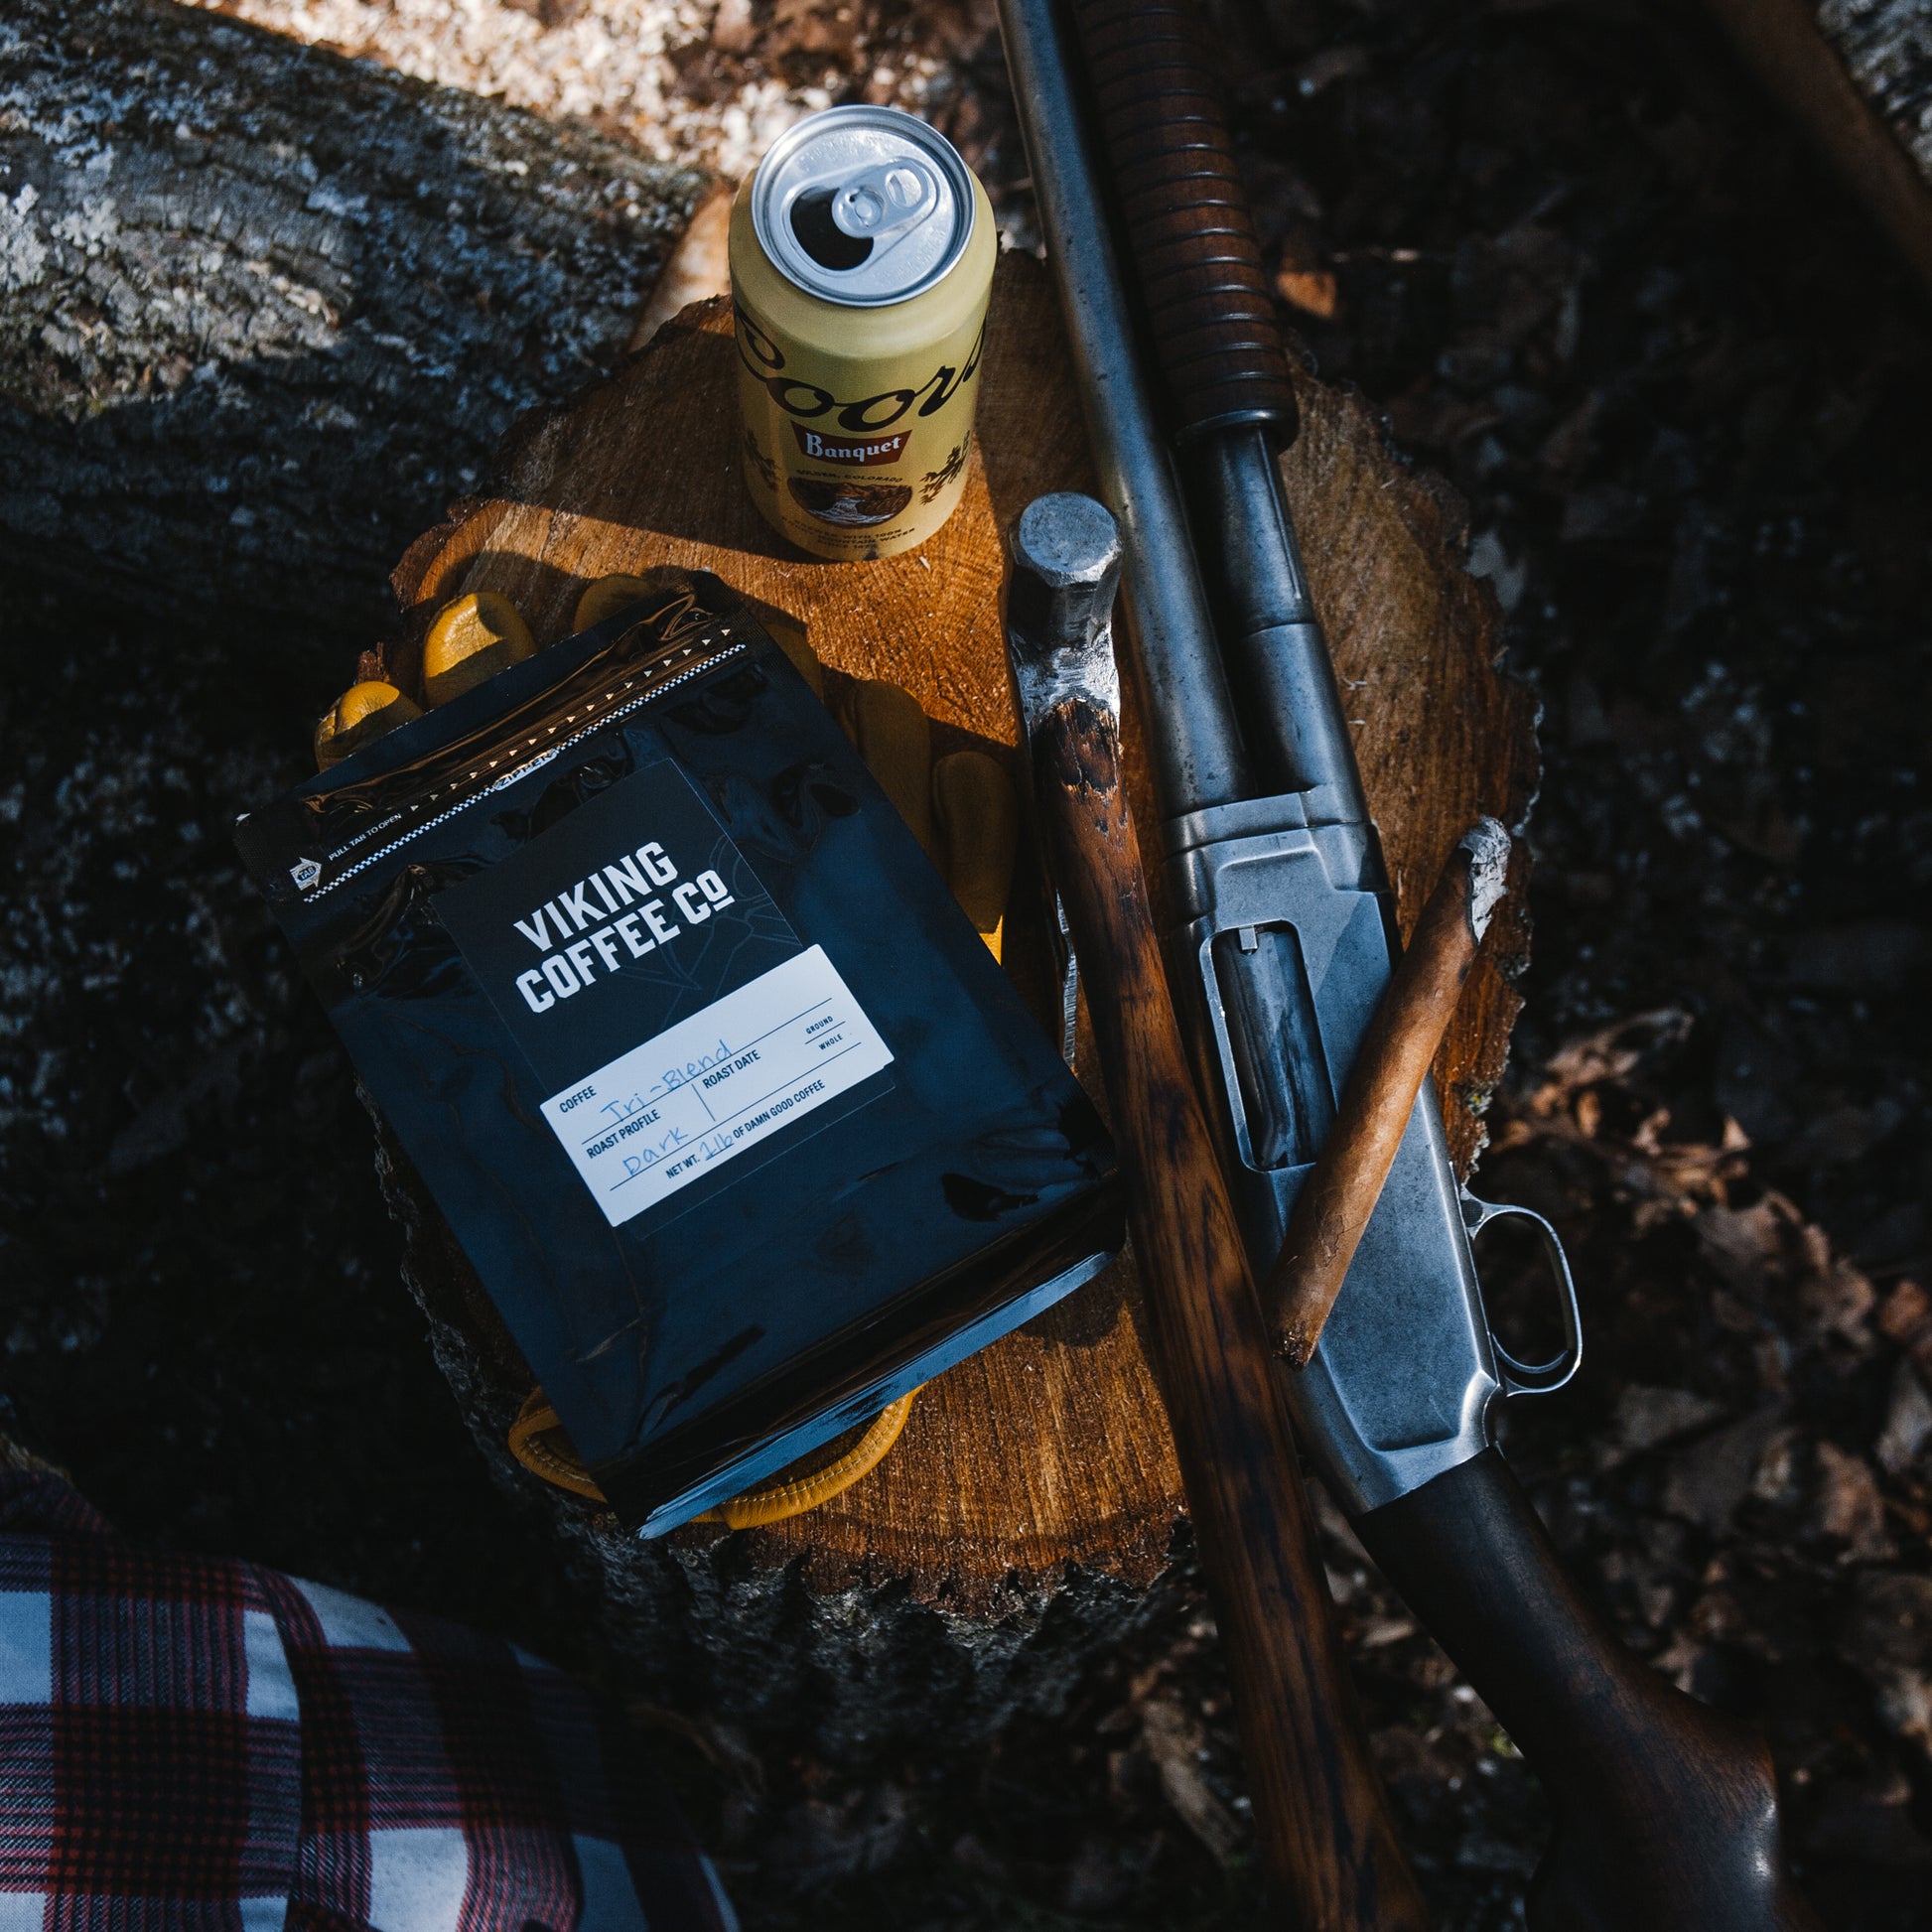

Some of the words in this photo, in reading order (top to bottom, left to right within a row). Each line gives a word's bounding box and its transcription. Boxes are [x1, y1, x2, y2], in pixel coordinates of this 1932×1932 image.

[805, 432, 901, 463] Banquet
[845, 475, 903, 483] COLORADO
[328, 845, 350, 862] PULL
[349, 834, 367, 847] TAB
[365, 826, 379, 836] TO
[377, 813, 402, 830] OPEN
[298, 865, 317, 881] TAB
[513, 841, 678, 952] VIKING
[515, 898, 681, 1014] COFFEE
[805, 1016, 835, 1035] GROUND
[818, 1033, 844, 1050] WHOLE
[702, 1063, 736, 1090] ROAST
[734, 1048, 761, 1071] DATE
[559, 1085, 597, 1114] COFFEE
[586, 1134, 620, 1160] ROAST
[619, 1108, 661, 1140] PROFILE
[665, 1162, 684, 1179] NET
[681, 1154, 701, 1170] WT.
[733, 1126, 747, 1140] OF
[744, 1111, 771, 1134] DAMN
[768, 1097, 794, 1118] GOOD
[792, 1078, 826, 1104] COFFEE
[621, 1127, 689, 1176] Dark
